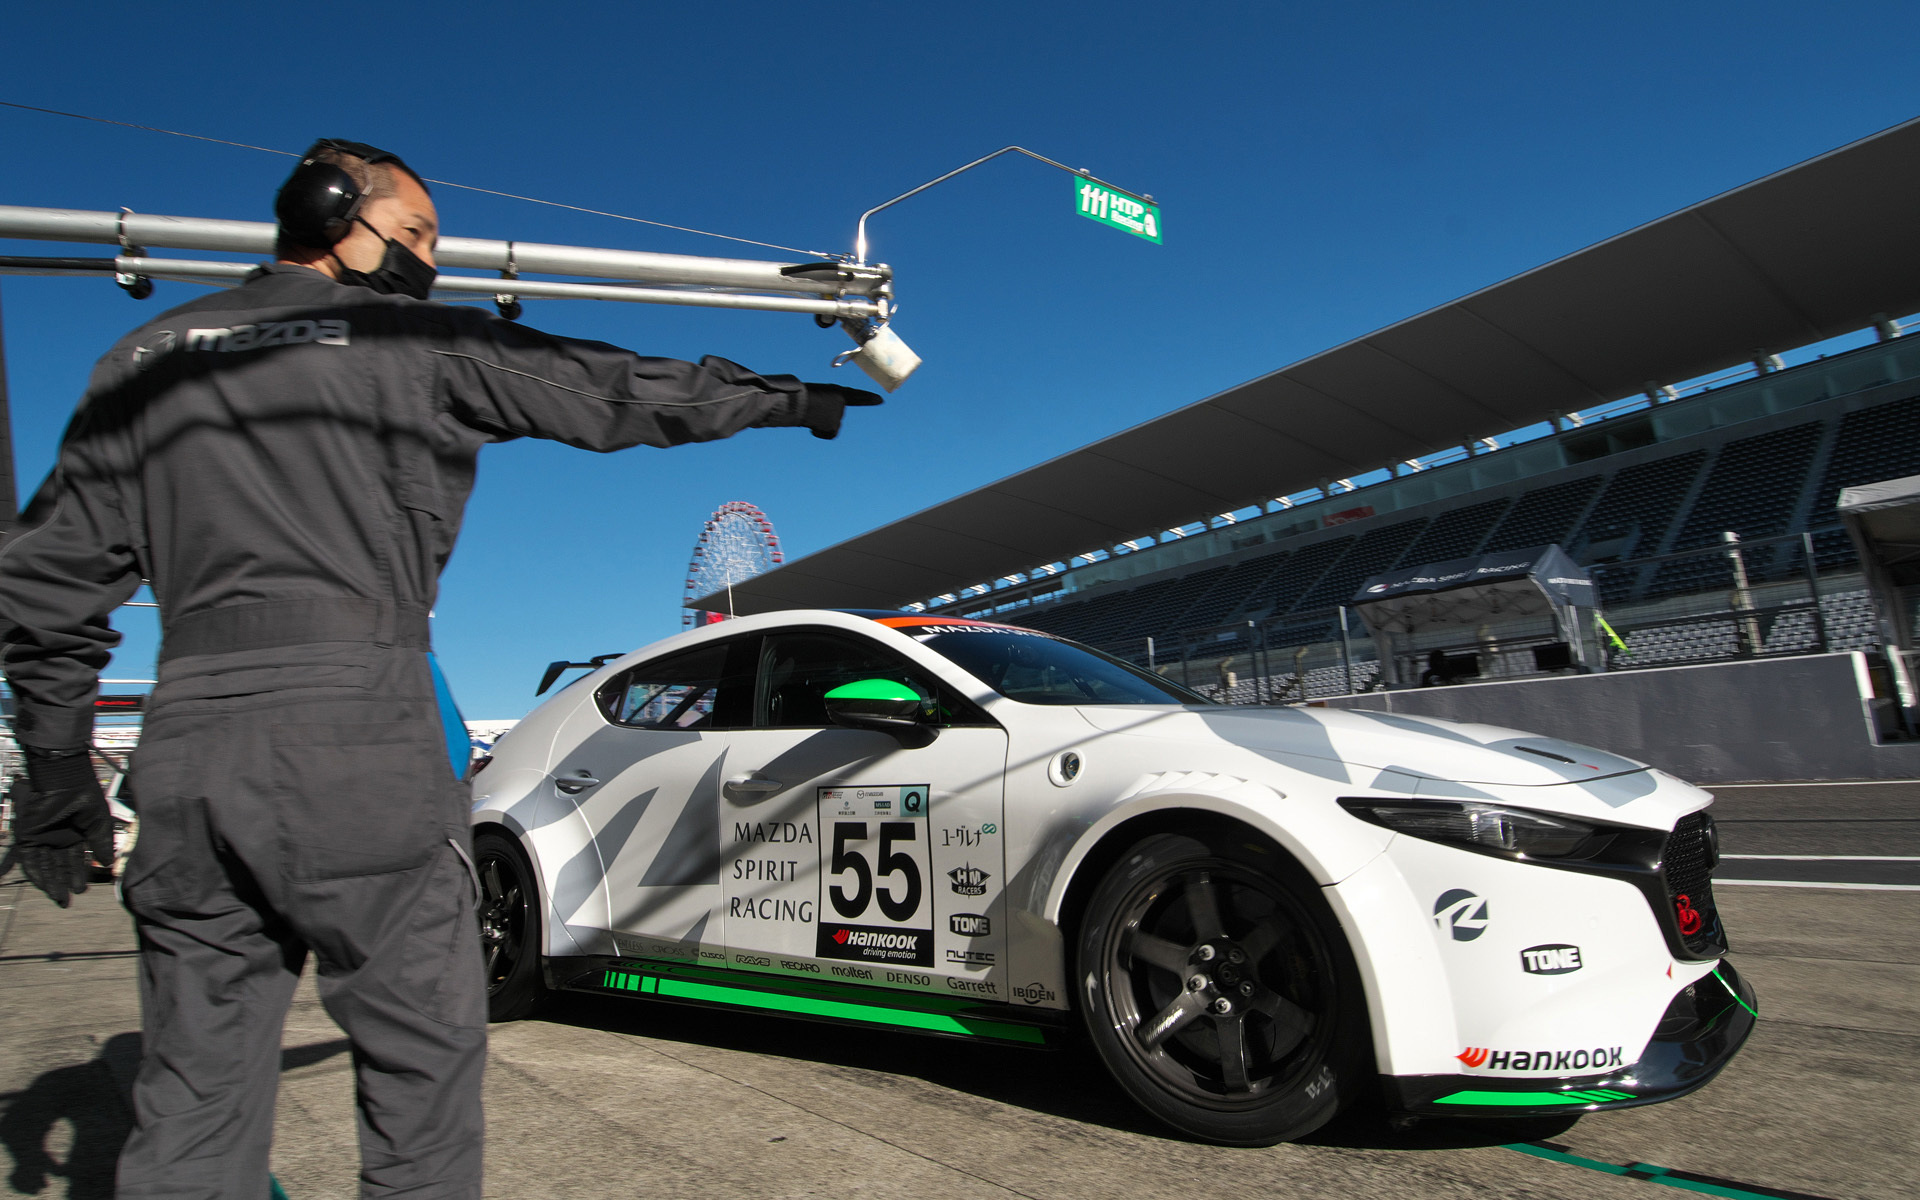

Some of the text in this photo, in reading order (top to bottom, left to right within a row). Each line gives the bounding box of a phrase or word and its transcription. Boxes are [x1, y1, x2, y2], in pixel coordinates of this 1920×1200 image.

[1080, 184, 1109, 219] 111
[1110, 194, 1144, 217] HTP
[921, 625, 1009, 635] MAZDA
[904, 791, 921, 812] Q
[734, 822, 812, 843] MAZDA
[942, 825, 982, 847] ユーグレナ
[733, 858, 798, 882] SPIRIT
[829, 822, 922, 922] 55
[957, 885, 982, 895] RACERS
[730, 896, 813, 923] RACING
[952, 916, 988, 934] TONE
[736, 954, 771, 966] RAYS
[863, 947, 916, 960] driving emotion
[1523, 948, 1581, 971] TONE
[780, 960, 820, 973] RECARO
[831, 965, 873, 980] molten
[886, 971, 931, 986] DENSO
[946, 976, 998, 995] Garrett
[1013, 986, 1056, 1001] IBIDEN
